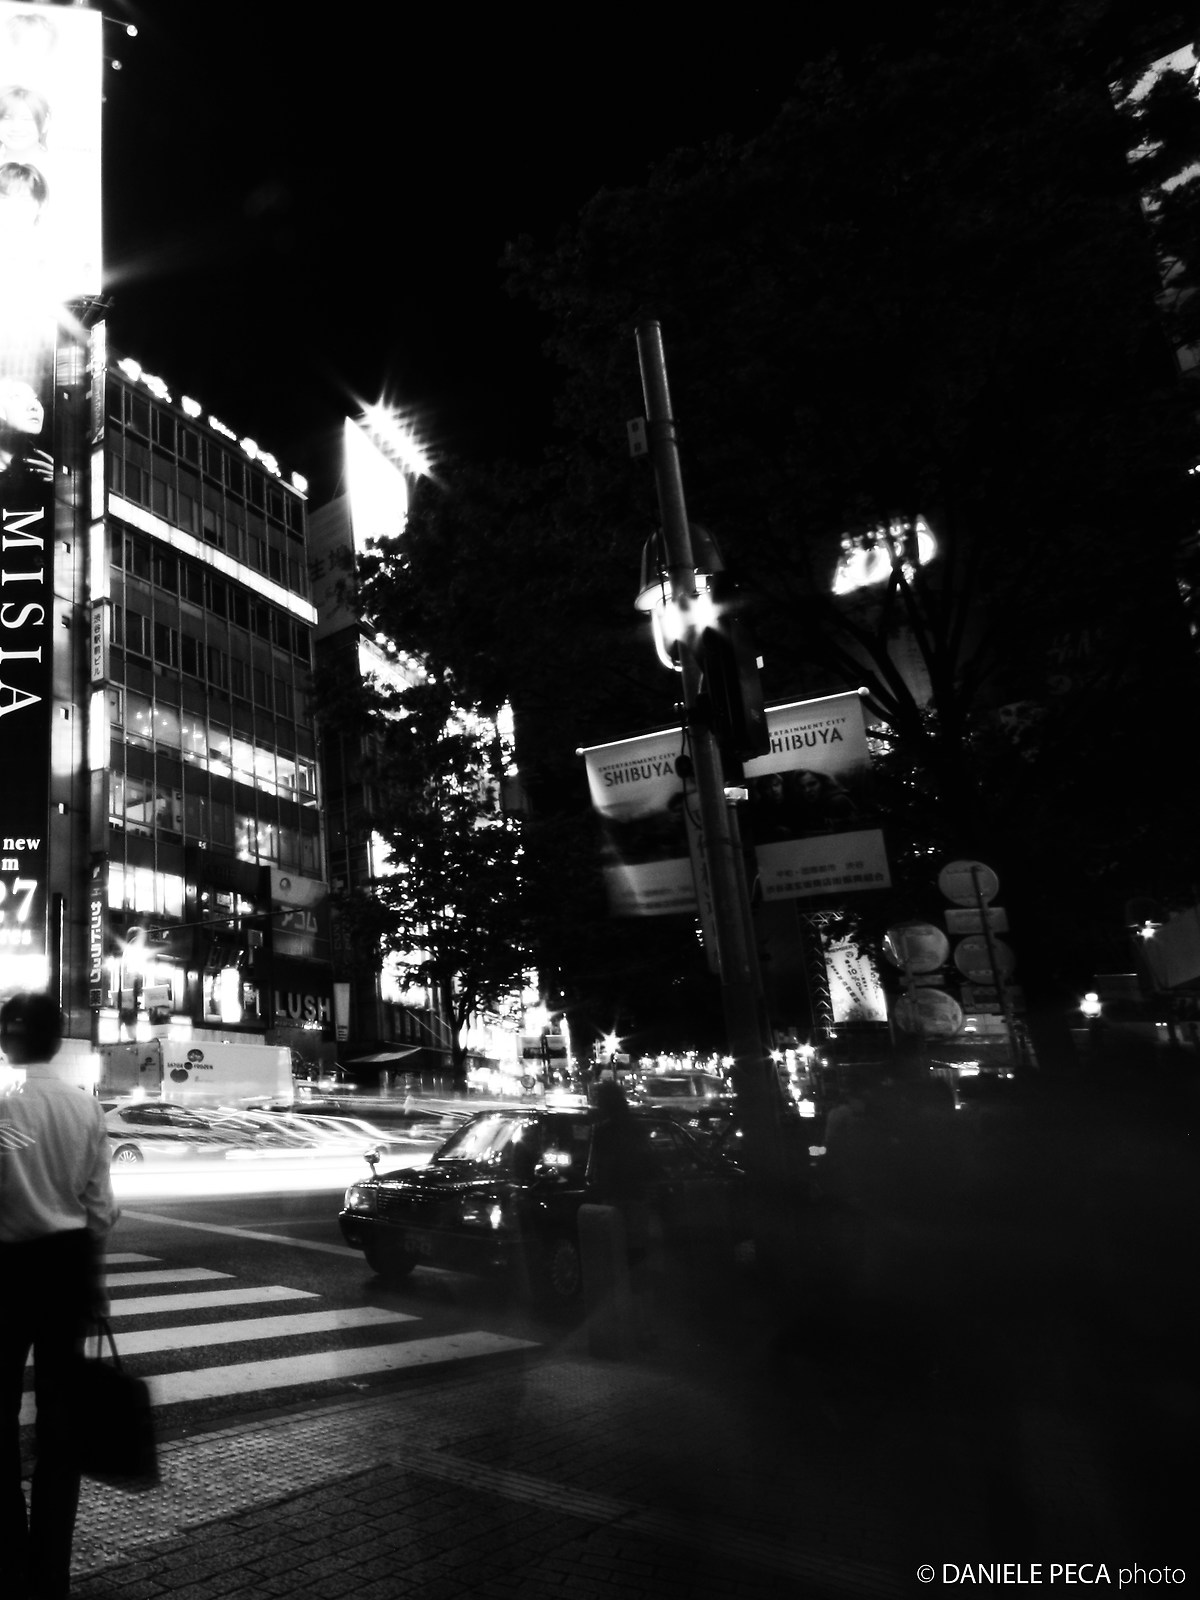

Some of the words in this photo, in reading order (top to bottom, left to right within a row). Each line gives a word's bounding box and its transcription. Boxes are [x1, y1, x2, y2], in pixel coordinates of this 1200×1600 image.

[769, 722, 823, 737] ERTAINMENT
[826, 718, 846, 726] CITY
[771, 727, 843, 754] HIBUYA
[659, 753, 676, 761] CITY
[604, 761, 674, 787] SHIBUYA
[3, 838, 40, 850] new
[274, 990, 332, 1022] LUSH
